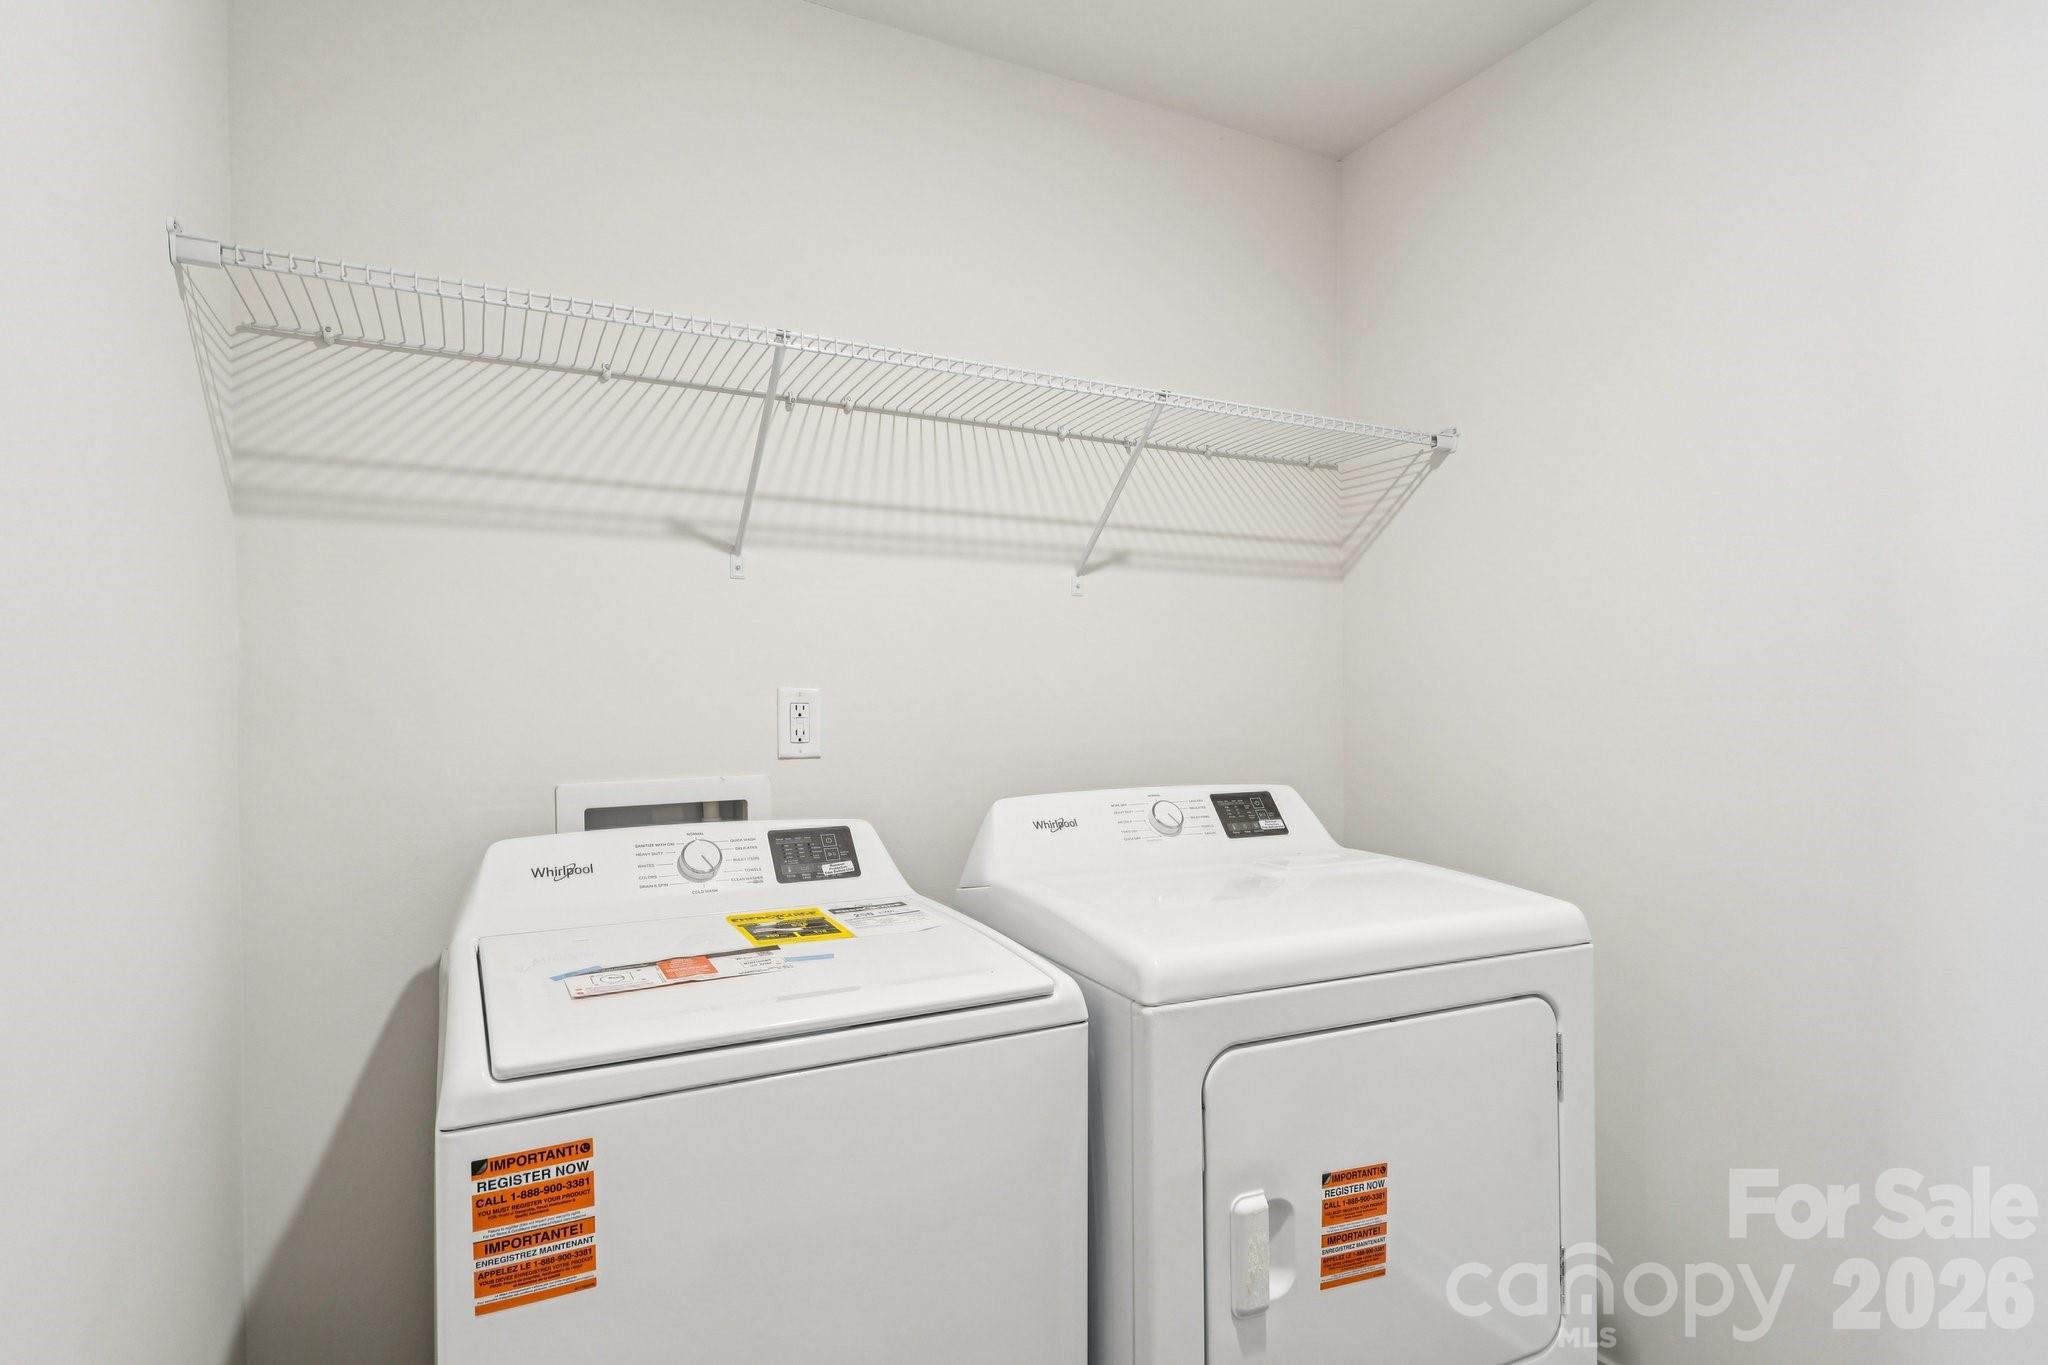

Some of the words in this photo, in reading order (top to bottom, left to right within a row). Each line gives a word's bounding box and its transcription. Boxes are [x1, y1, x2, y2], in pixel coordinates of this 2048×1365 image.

[1032, 818, 1078, 832] Whirlpool
[530, 862, 594, 882] Whirlpool
[490, 1145, 579, 1172] IMPORTANT!
[477, 1168, 550, 1193] REGISTER
[556, 1160, 589, 1177] NOW
[1331, 1168, 1380, 1182] IMPORTANT!
[476, 1194, 507, 1208] CALL
[511, 1177, 590, 1201] 1-888-900-3381
[1324, 1183, 1365, 1198] REGISTER
[1366, 1180, 1385, 1190] NOW
[477, 1208, 491, 1217] YOU
[492, 1205, 510, 1215] MUST
[512, 1199, 542, 1210] REGISTER
[544, 1194, 561, 1204] YOUR
[562, 1189, 591, 1199] PRODUCT
[1324, 1200, 1340, 1210] CALL
[484, 1223, 583, 1255] IMPORTANTE!
[1322, 1244, 1355, 1255] ENREGISTREZ
[1356, 1237, 1386, 1248] MAINTENANT
[1327, 1226, 1380, 1245] IMPORTANTE!
[475, 1248, 537, 1269] ENREGISTREZ
[539, 1236, 594, 1255] MAINTENANT
[478, 1264, 518, 1280] APPELEZ
[520, 1261, 531, 1271] LE
[534, 1248, 592, 1268] 1-888-900-3381
